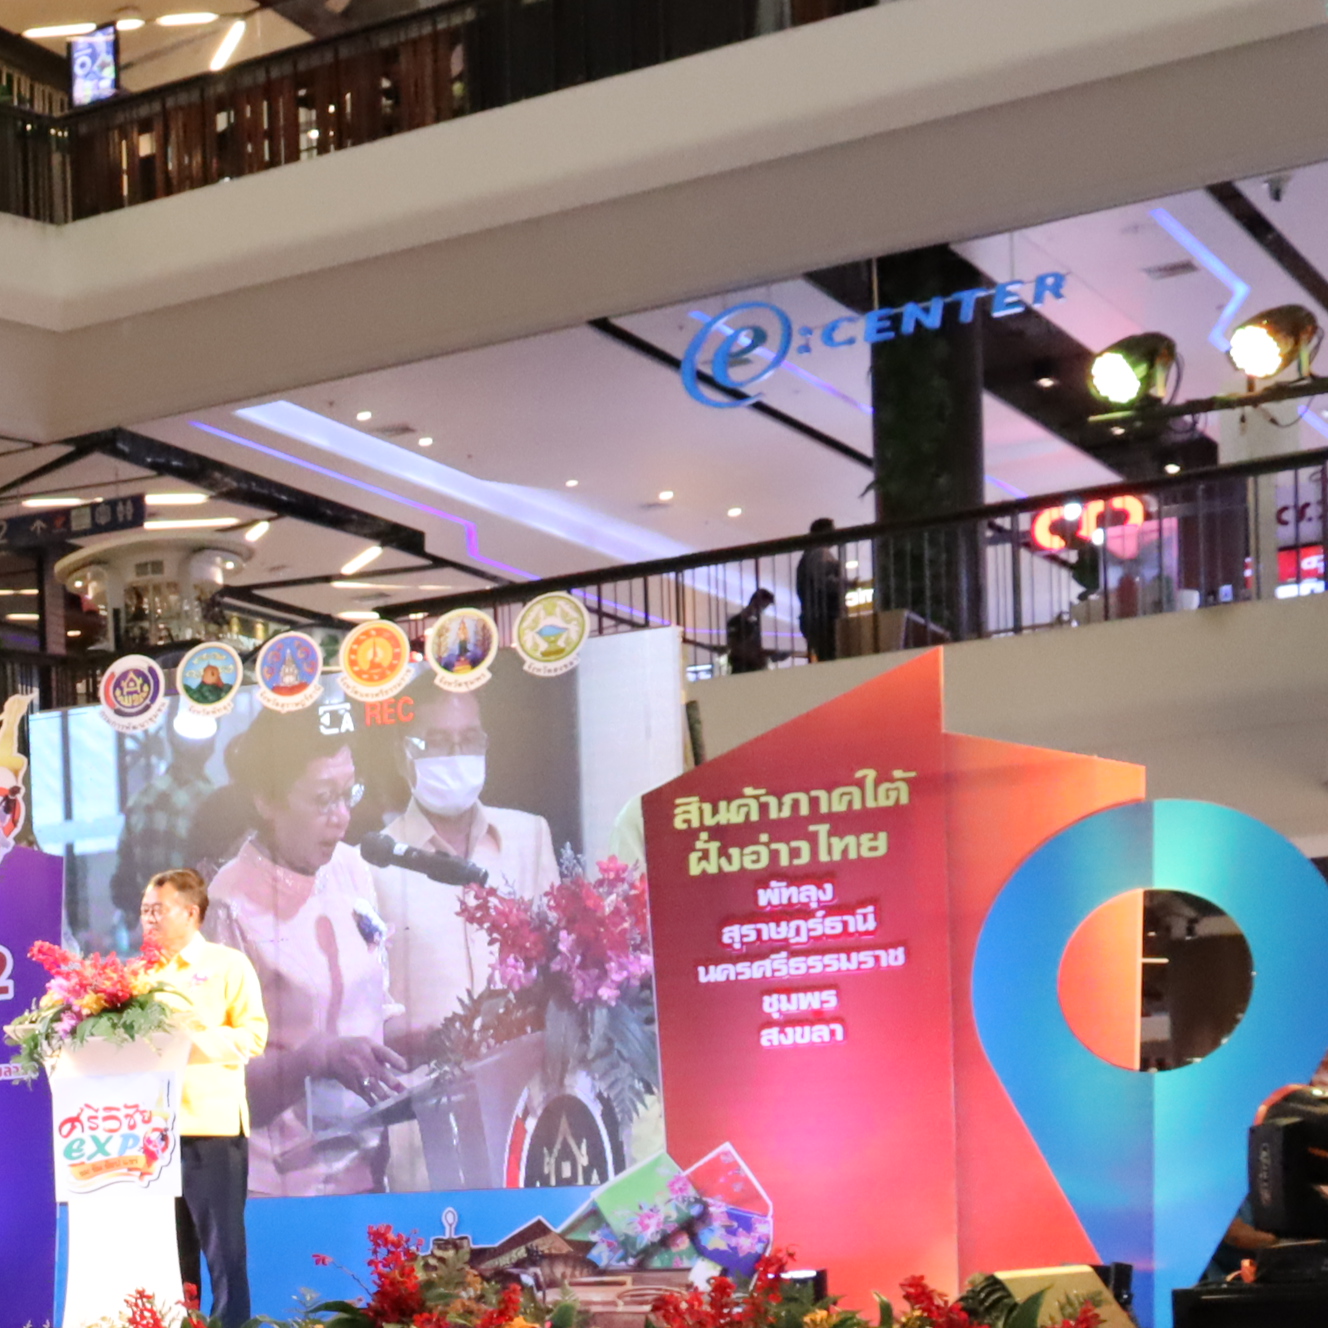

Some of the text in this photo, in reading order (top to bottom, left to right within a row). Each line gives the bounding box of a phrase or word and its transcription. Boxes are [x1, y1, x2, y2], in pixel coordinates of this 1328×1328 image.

[364, 696, 416, 727] REC
[672, 768, 917, 830] สินค้าภาคใต้
[757, 880, 835, 909] พัทลุง
[721, 905, 877, 949] สุราษฎร์ธานี
[697, 945, 906, 983] นครศรีธรรมราช
[762, 989, 838, 1018] ชุมพร
[760, 1022, 845, 1046] สงขลา
[58, 1103, 153, 1139] ศรีวิชัย
